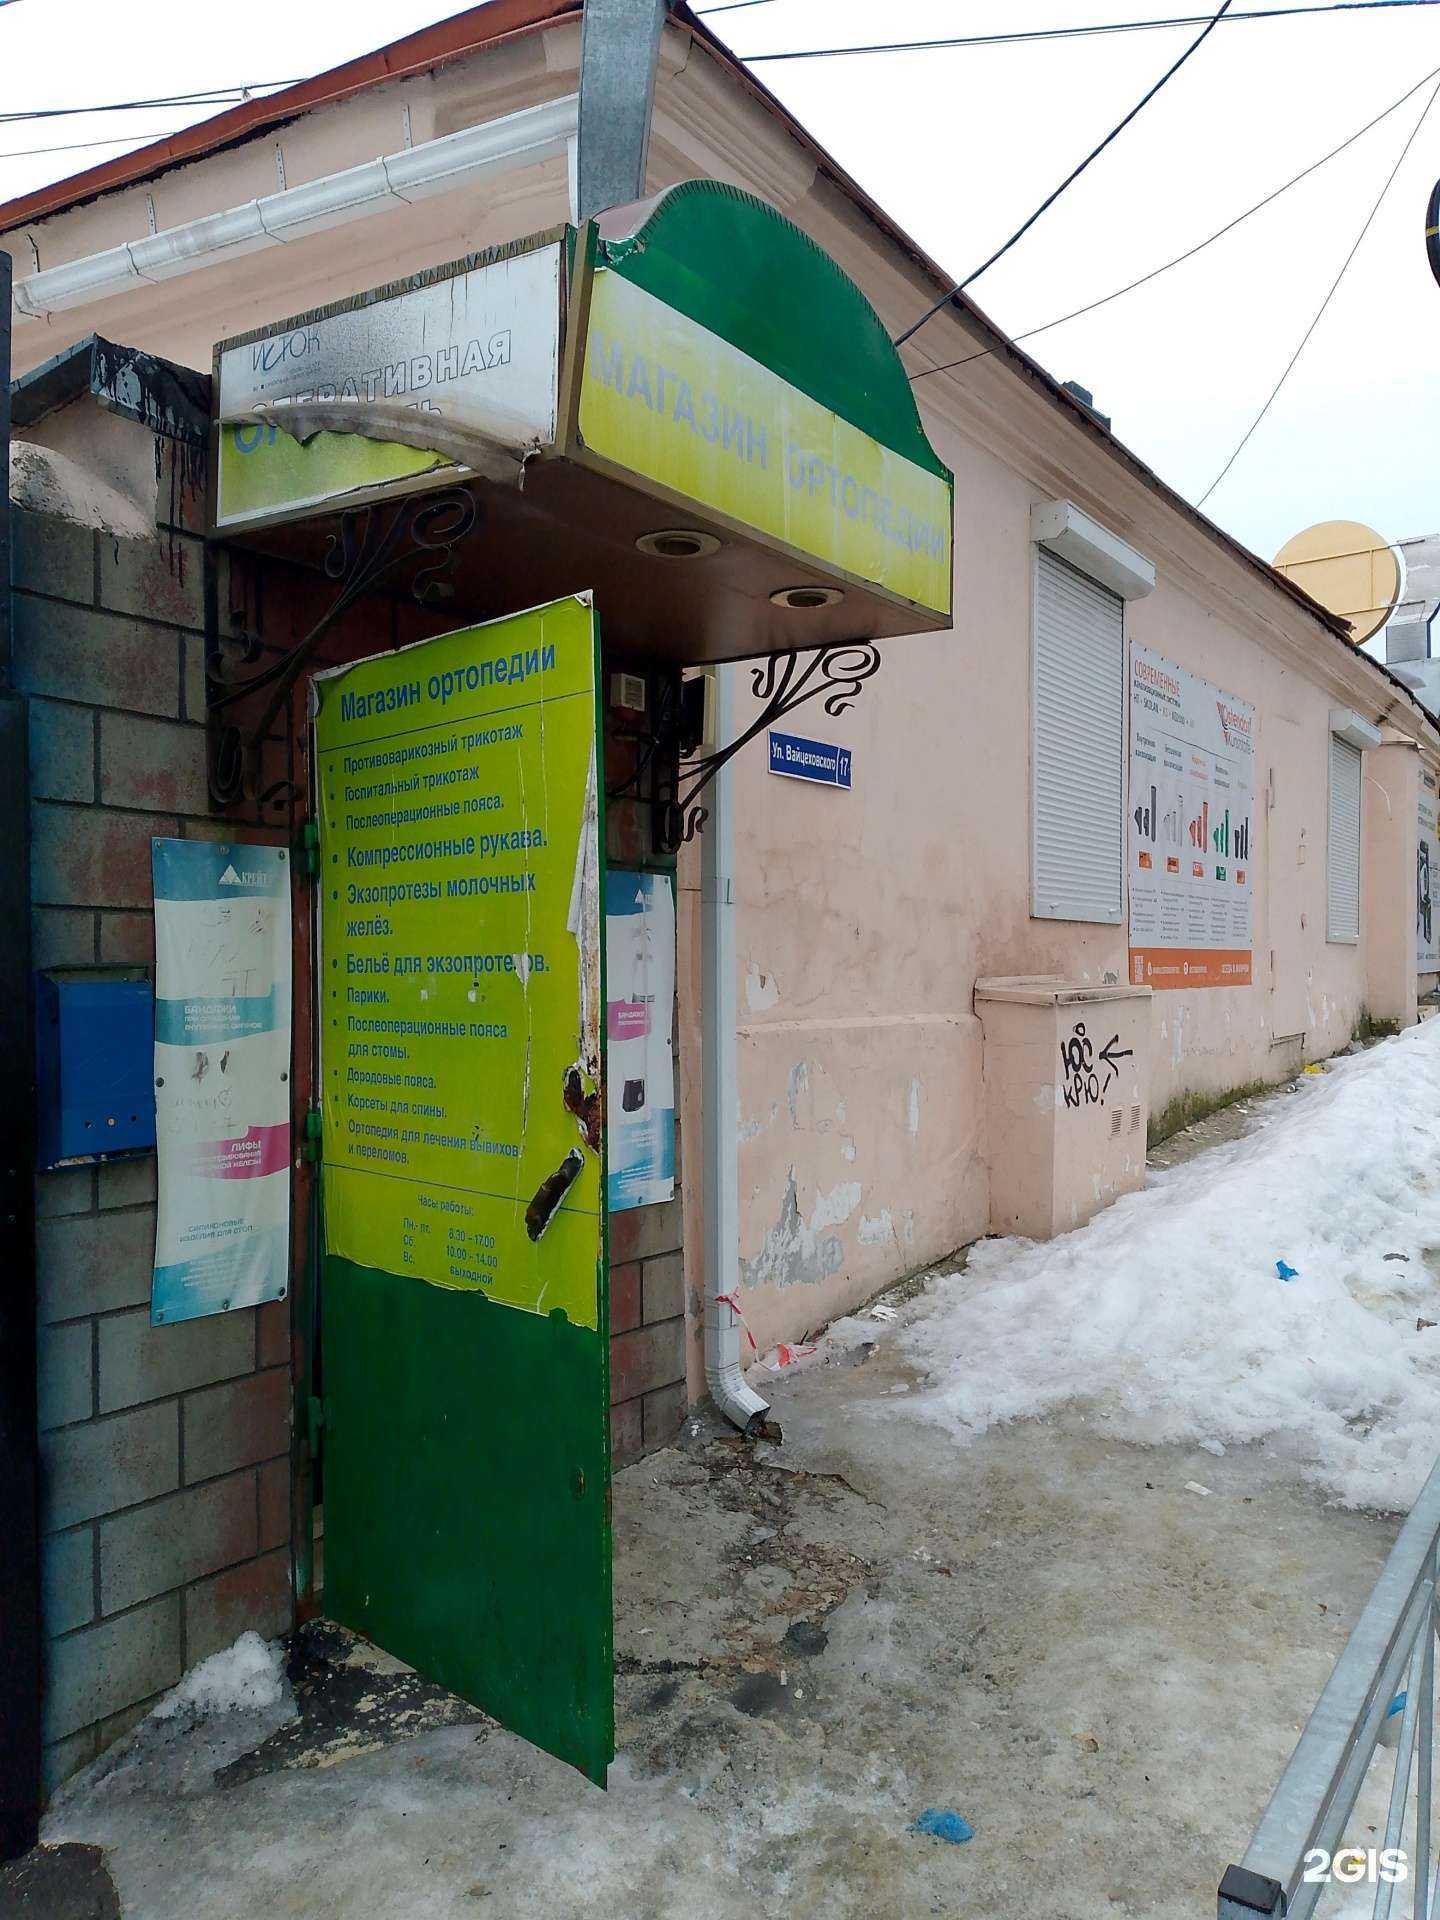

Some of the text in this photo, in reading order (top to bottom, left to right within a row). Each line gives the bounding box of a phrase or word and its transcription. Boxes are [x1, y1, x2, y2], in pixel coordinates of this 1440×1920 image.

[590, 329, 945, 565] МАГАЗИН ОРТОПЕДИИ
[341, 643, 556, 722] Магазин ортопедии
[344, 723, 523, 775] Противоварикозный трикотаж
[772, 741, 785, 760] Ул.
[839, 756, 850, 777] 17
[345, 763, 480, 802] Госпитальный трикотаж
[346, 793, 505, 831] Послеоперационные пояса.
[348, 835, 475, 869] Компрессионные
[347, 870, 536, 907] Экзопротезы молочных
[347, 911, 393, 937] желёз.
[346, 951, 550, 978] Бельё для экзопротеов.
[347, 986, 390, 1005] Парики.
[347, 1015, 466, 1037] Послеоперационные
[348, 1043, 410, 1060] для стомы.
[347, 1067, 437, 1090] Дородовые пояса.
[347, 1094, 448, 1119] Корсеты для спины.
[348, 1119, 399, 1140] Ортопедия
[401, 1129, 420, 1145] для
[423, 1132, 467, 1151] лечения
[348, 1145, 411, 1165] и переломов.
